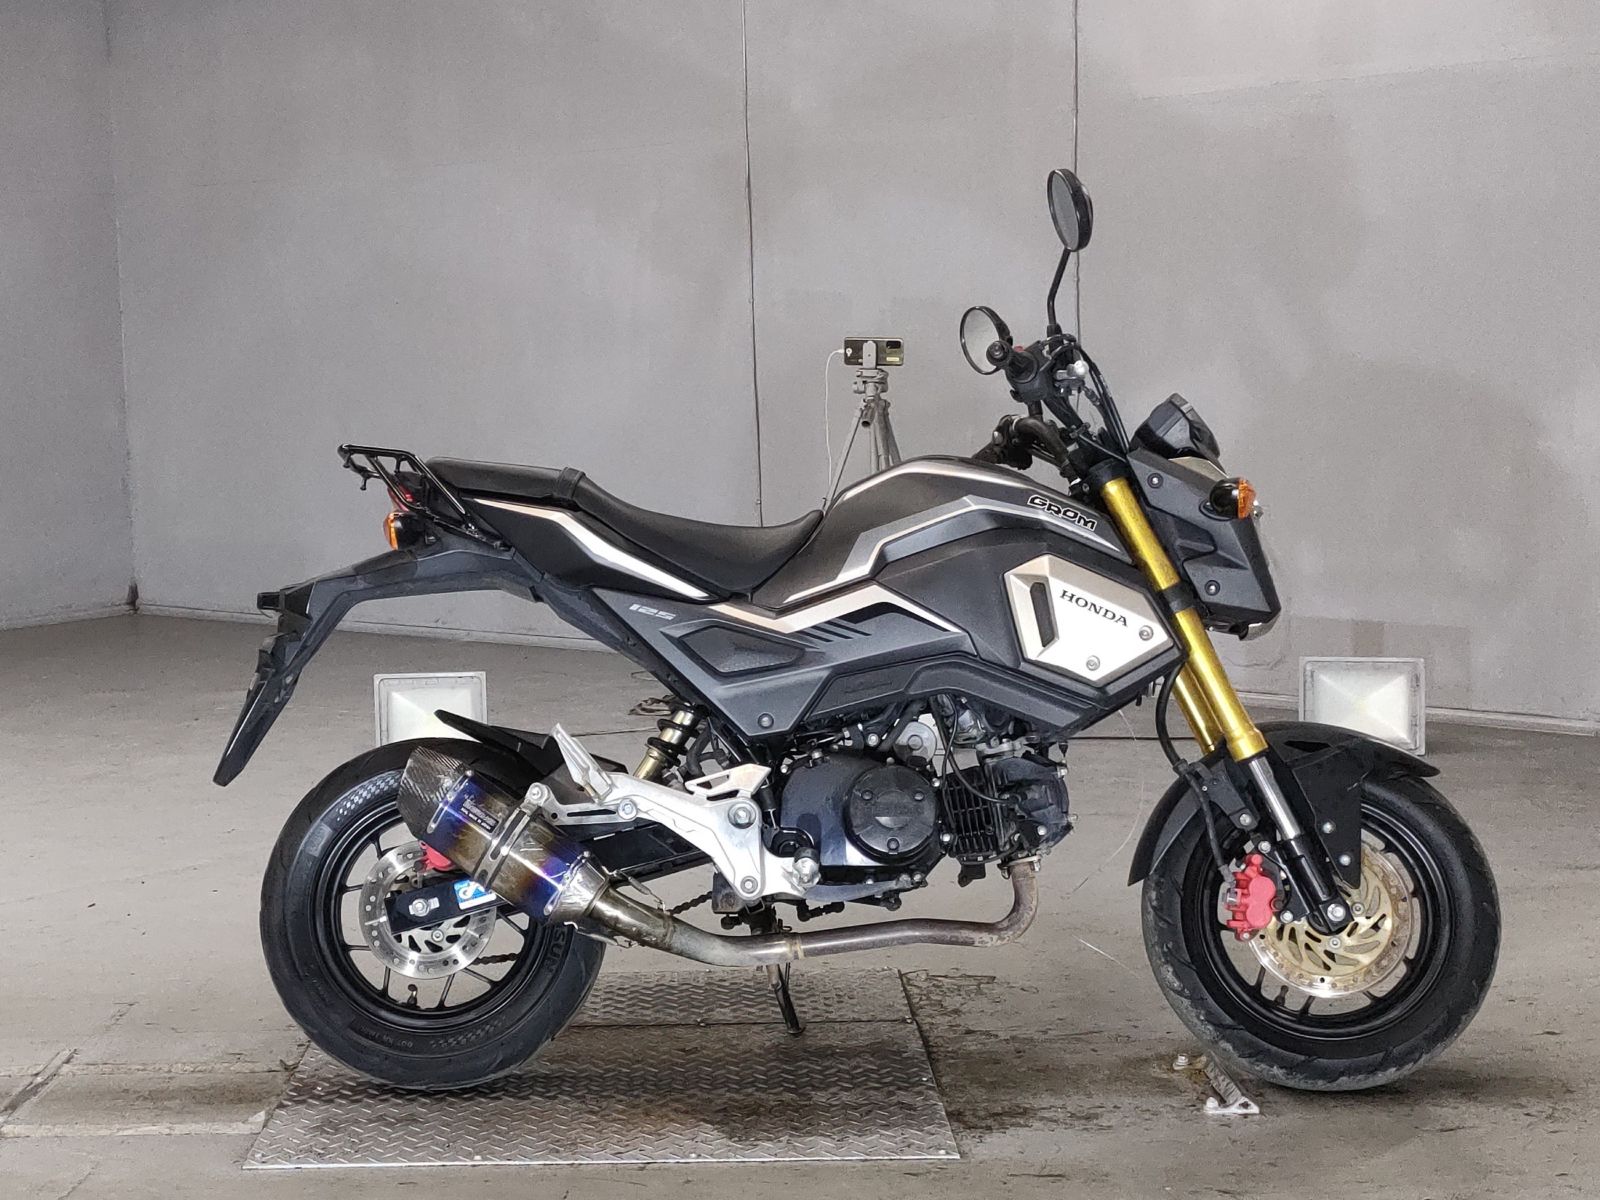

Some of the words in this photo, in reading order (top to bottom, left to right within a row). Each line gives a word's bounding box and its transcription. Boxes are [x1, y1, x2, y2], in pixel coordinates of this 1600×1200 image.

[1027, 495, 1097, 531] GROM
[629, 604, 676, 620] 125
[1060, 590, 1127, 626] HONDA
